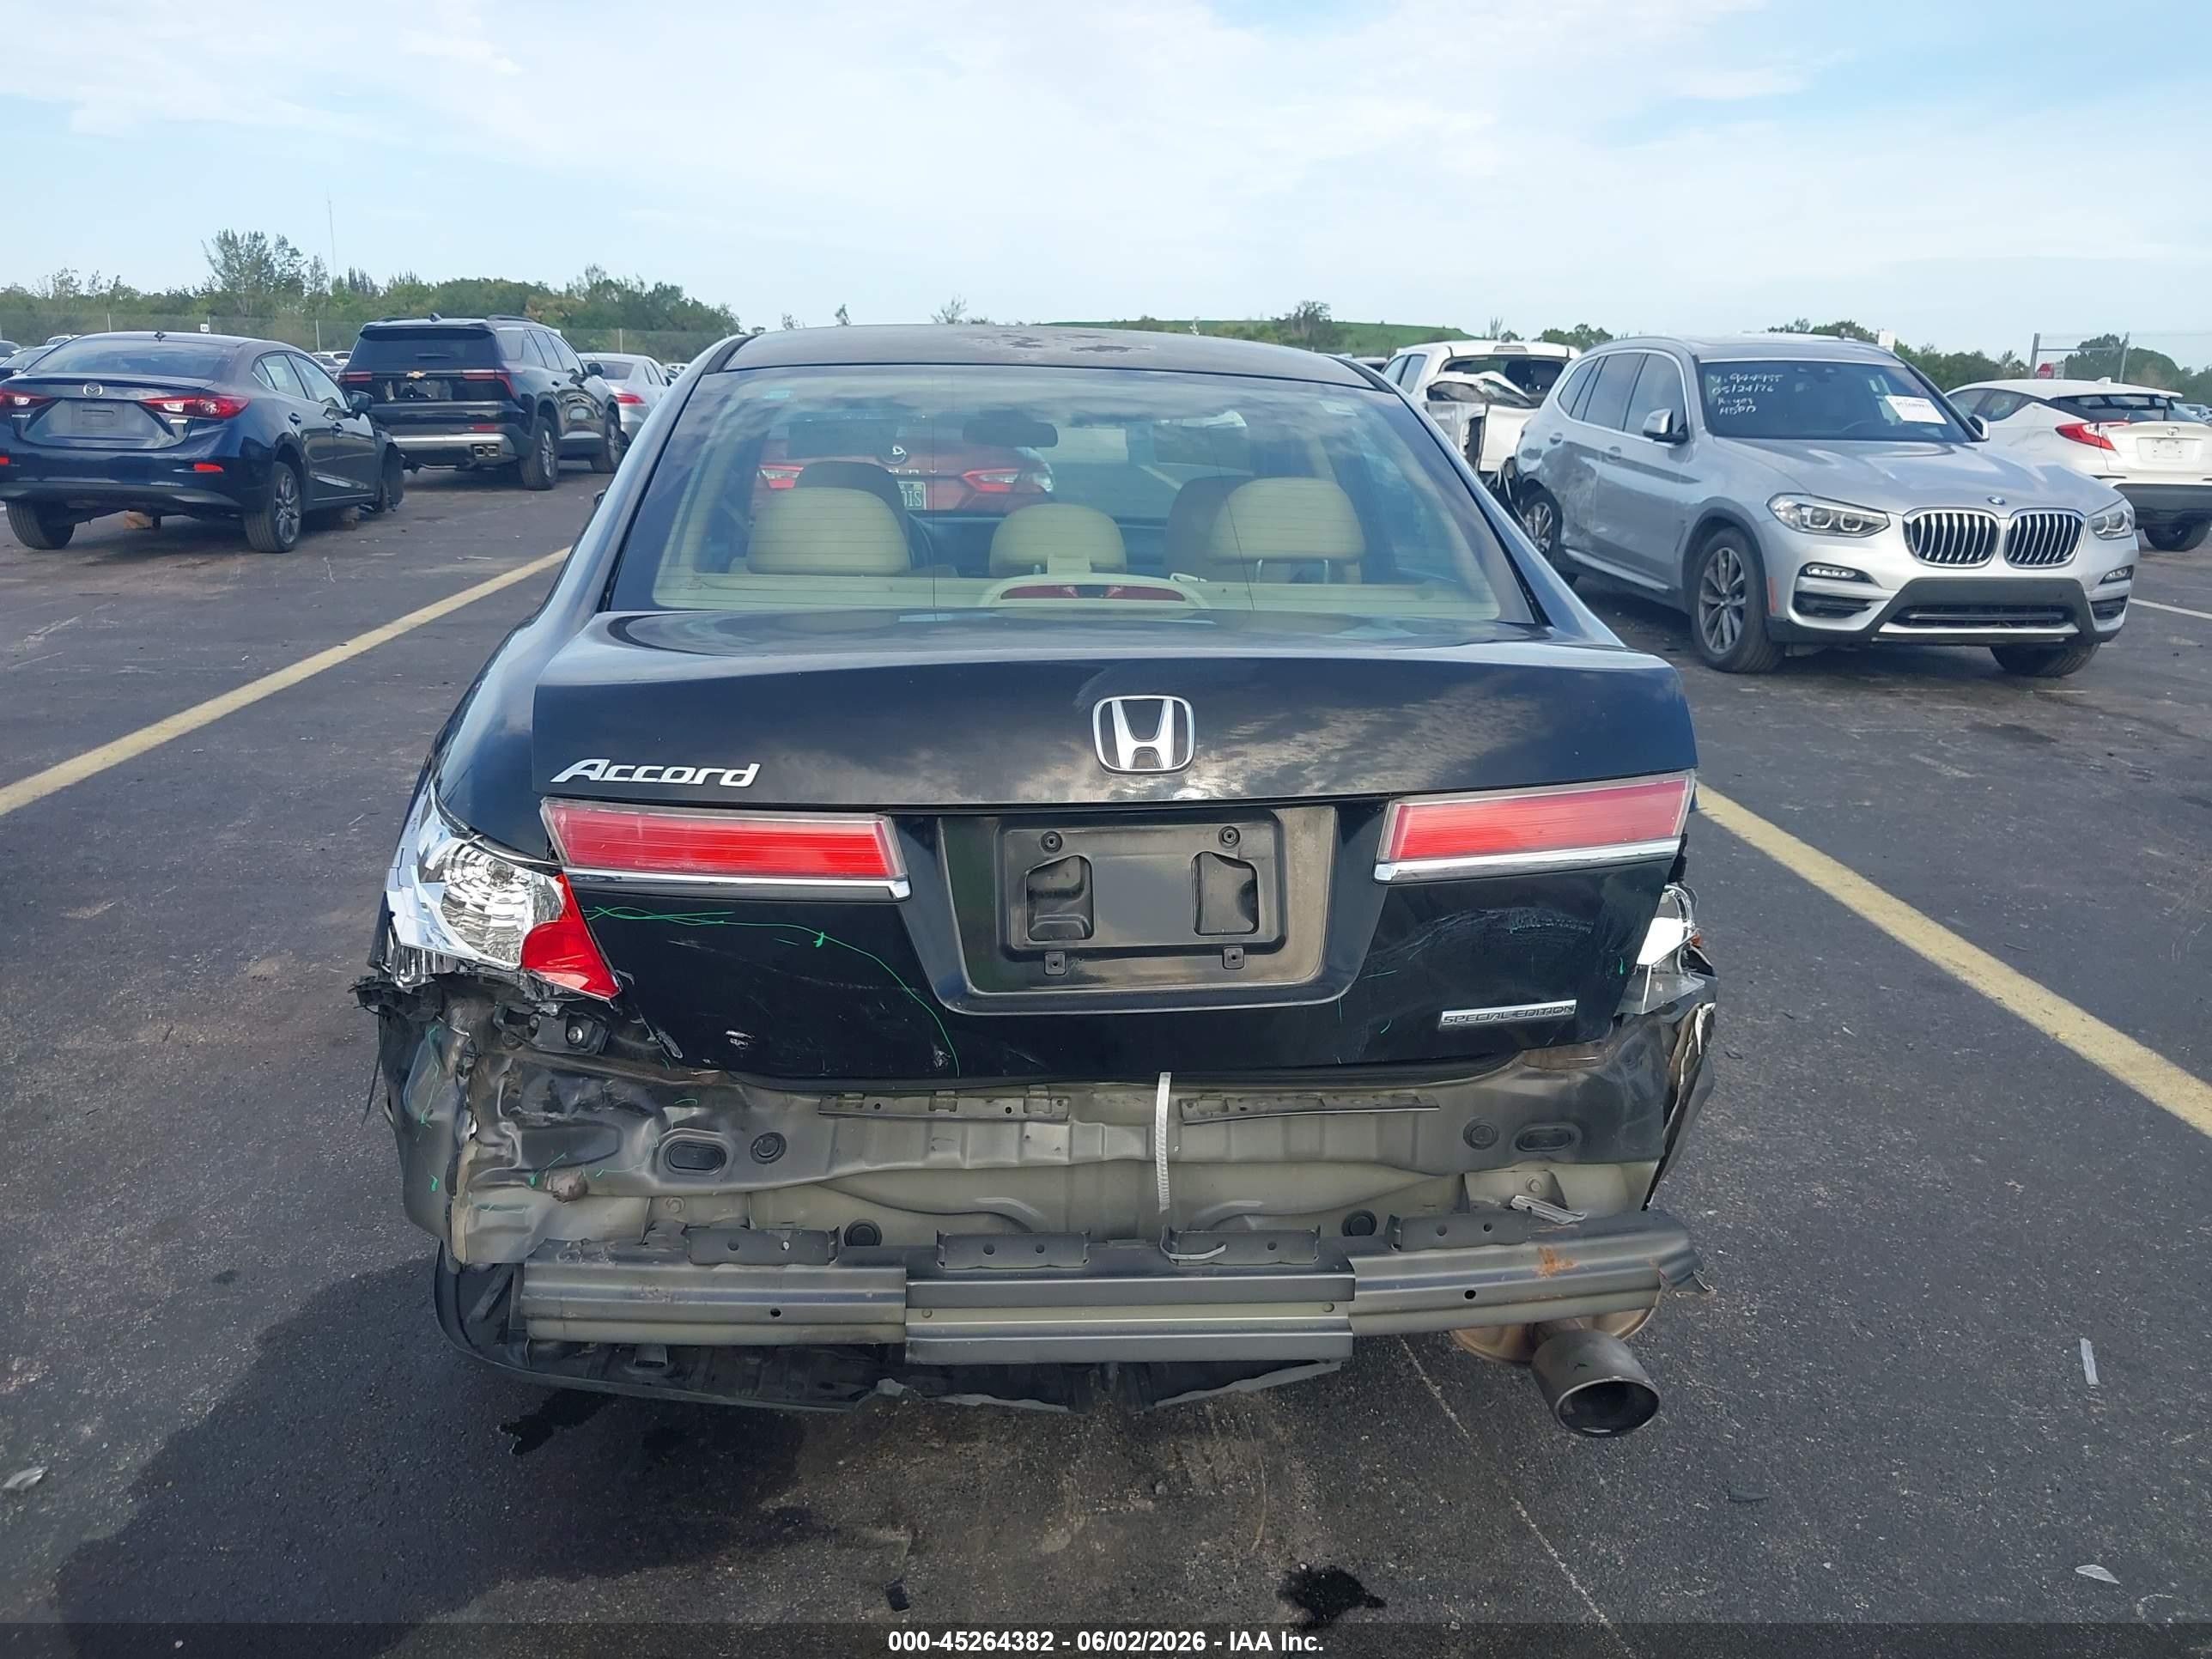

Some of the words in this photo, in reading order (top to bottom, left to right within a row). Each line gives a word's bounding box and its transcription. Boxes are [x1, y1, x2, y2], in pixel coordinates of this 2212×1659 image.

[550, 758, 761, 787] Accord
[1443, 1012, 1510, 1024] SPECIAL
[1515, 1005, 1575, 1018] EDITION
